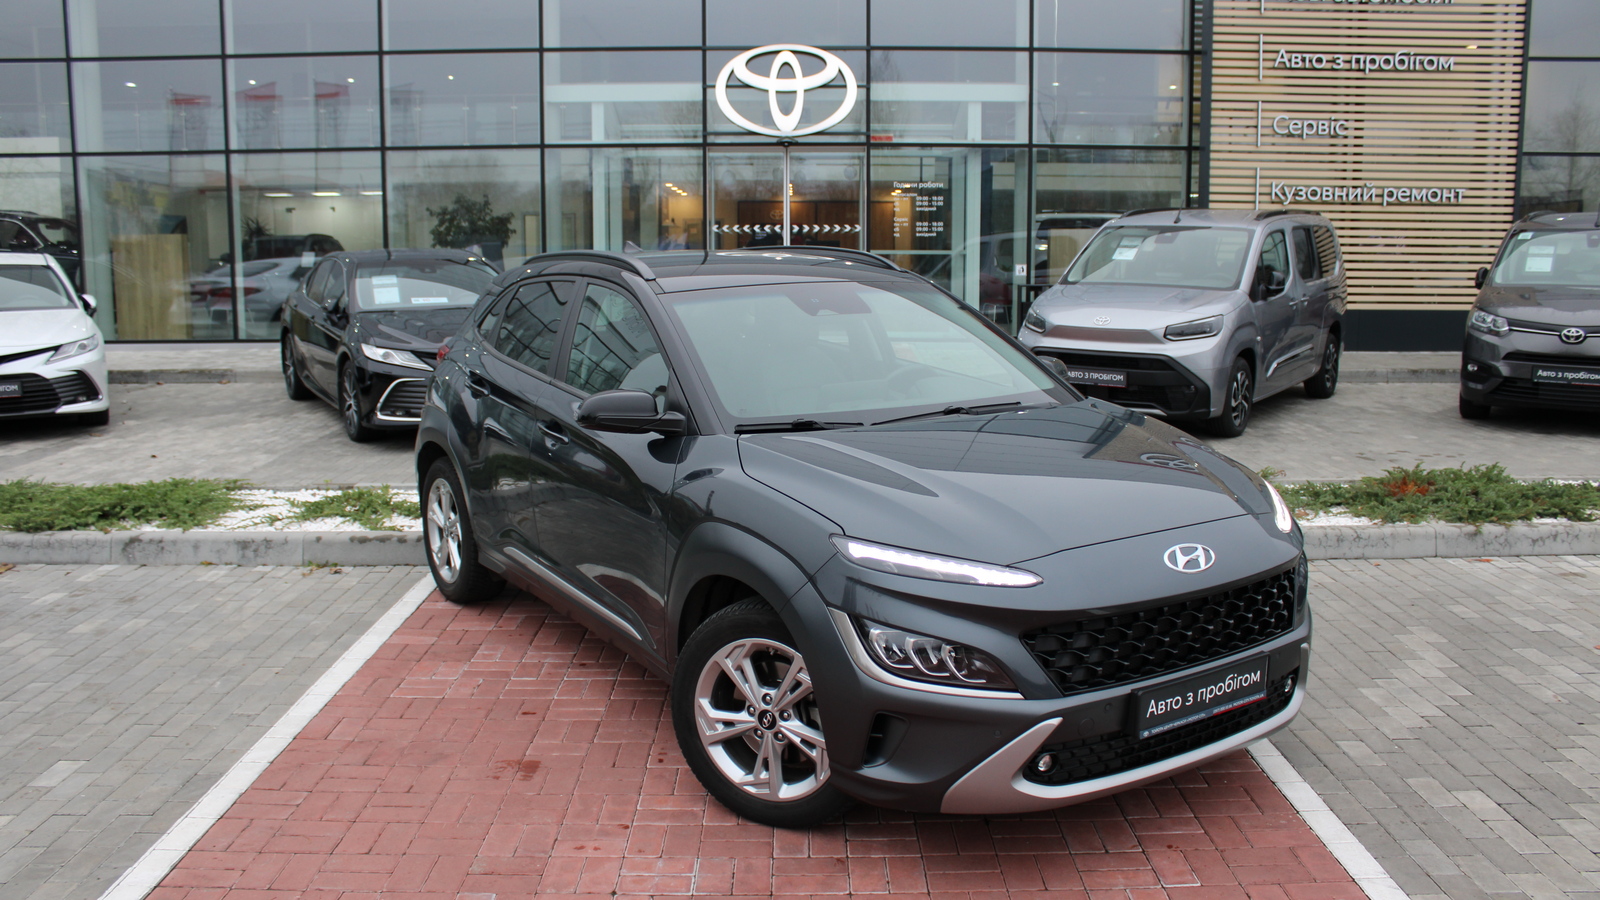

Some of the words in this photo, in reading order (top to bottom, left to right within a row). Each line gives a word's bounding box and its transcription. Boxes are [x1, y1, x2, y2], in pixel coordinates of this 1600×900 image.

[1274, 49, 1326, 69] Авто
[1332, 55, 1344, 69] з
[1351, 50, 1455, 75] пробігом
[1272, 115, 1348, 139] Сервіс
[919, 181, 943, 189] роботи
[1271, 181, 1376, 205] Кузовний
[1383, 186, 1466, 207] ремонт
[1090, 373, 1123, 381] ПРОБІГОМ
[1537, 369, 1556, 378] Авто
[1146, 696, 1182, 718] Авто
[1185, 692, 1194, 706] з
[1197, 670, 1261, 703] пробігом
